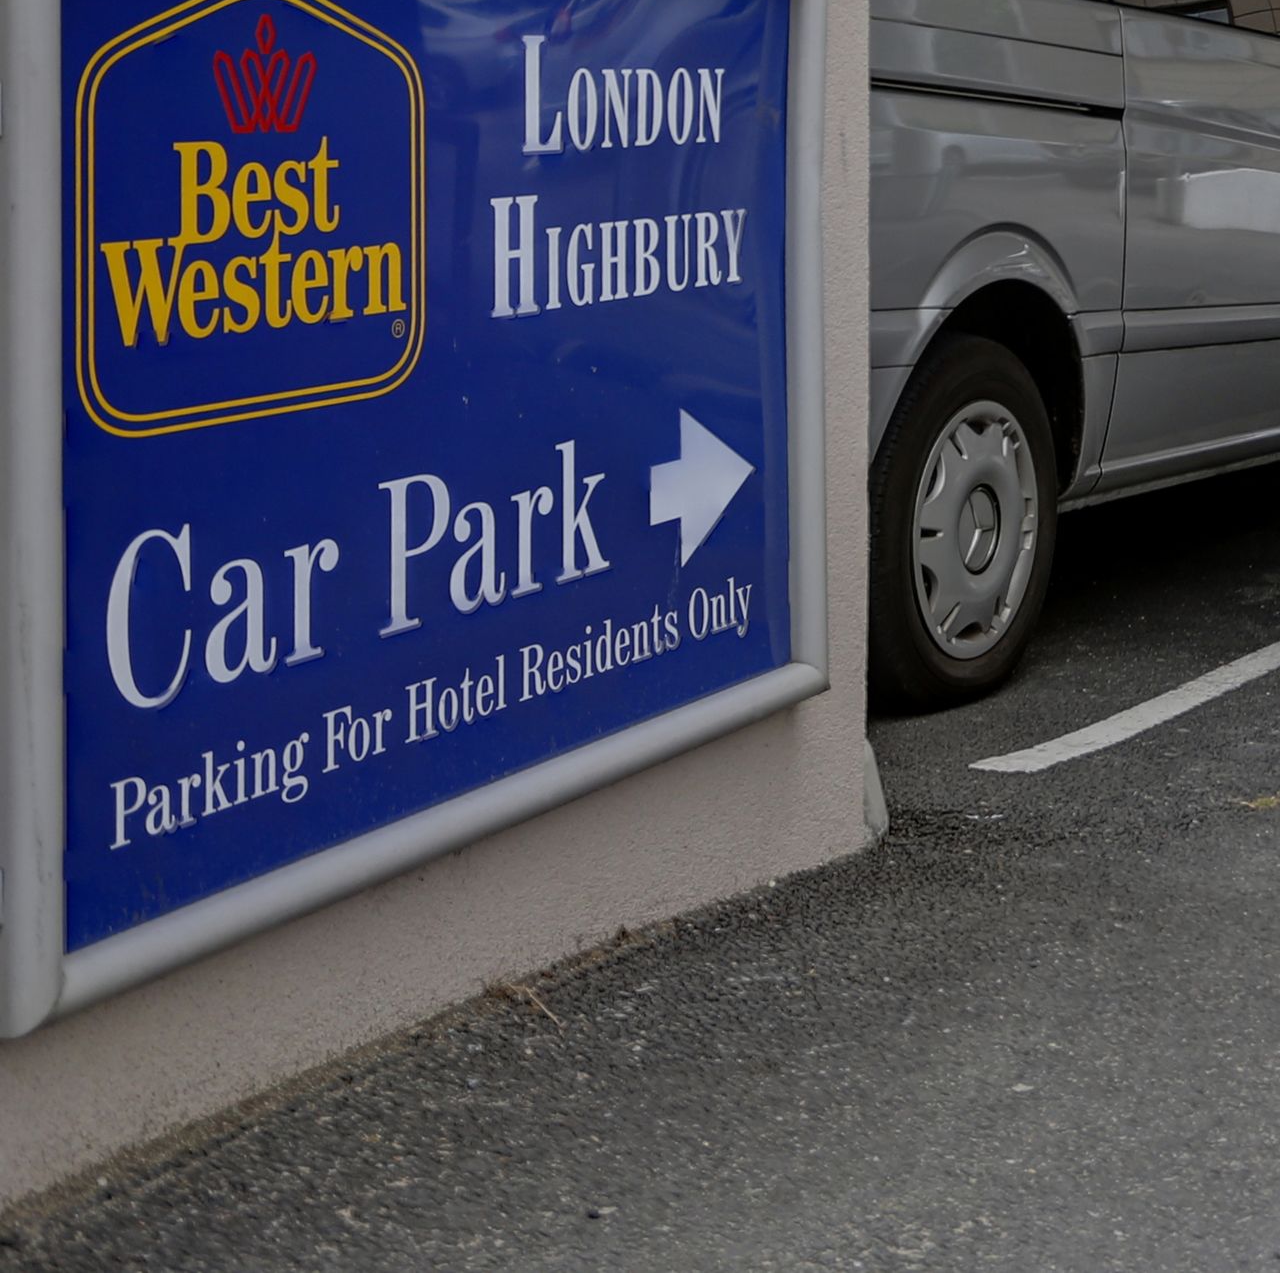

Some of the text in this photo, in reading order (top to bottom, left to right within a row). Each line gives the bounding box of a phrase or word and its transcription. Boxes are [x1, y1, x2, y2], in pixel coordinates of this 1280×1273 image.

[171, 135, 340, 244] Best
[99, 231, 407, 348] Western
[106, 439, 611, 711] Car Park
[109, 576, 753, 851] Parking For Hotel Residents Only
